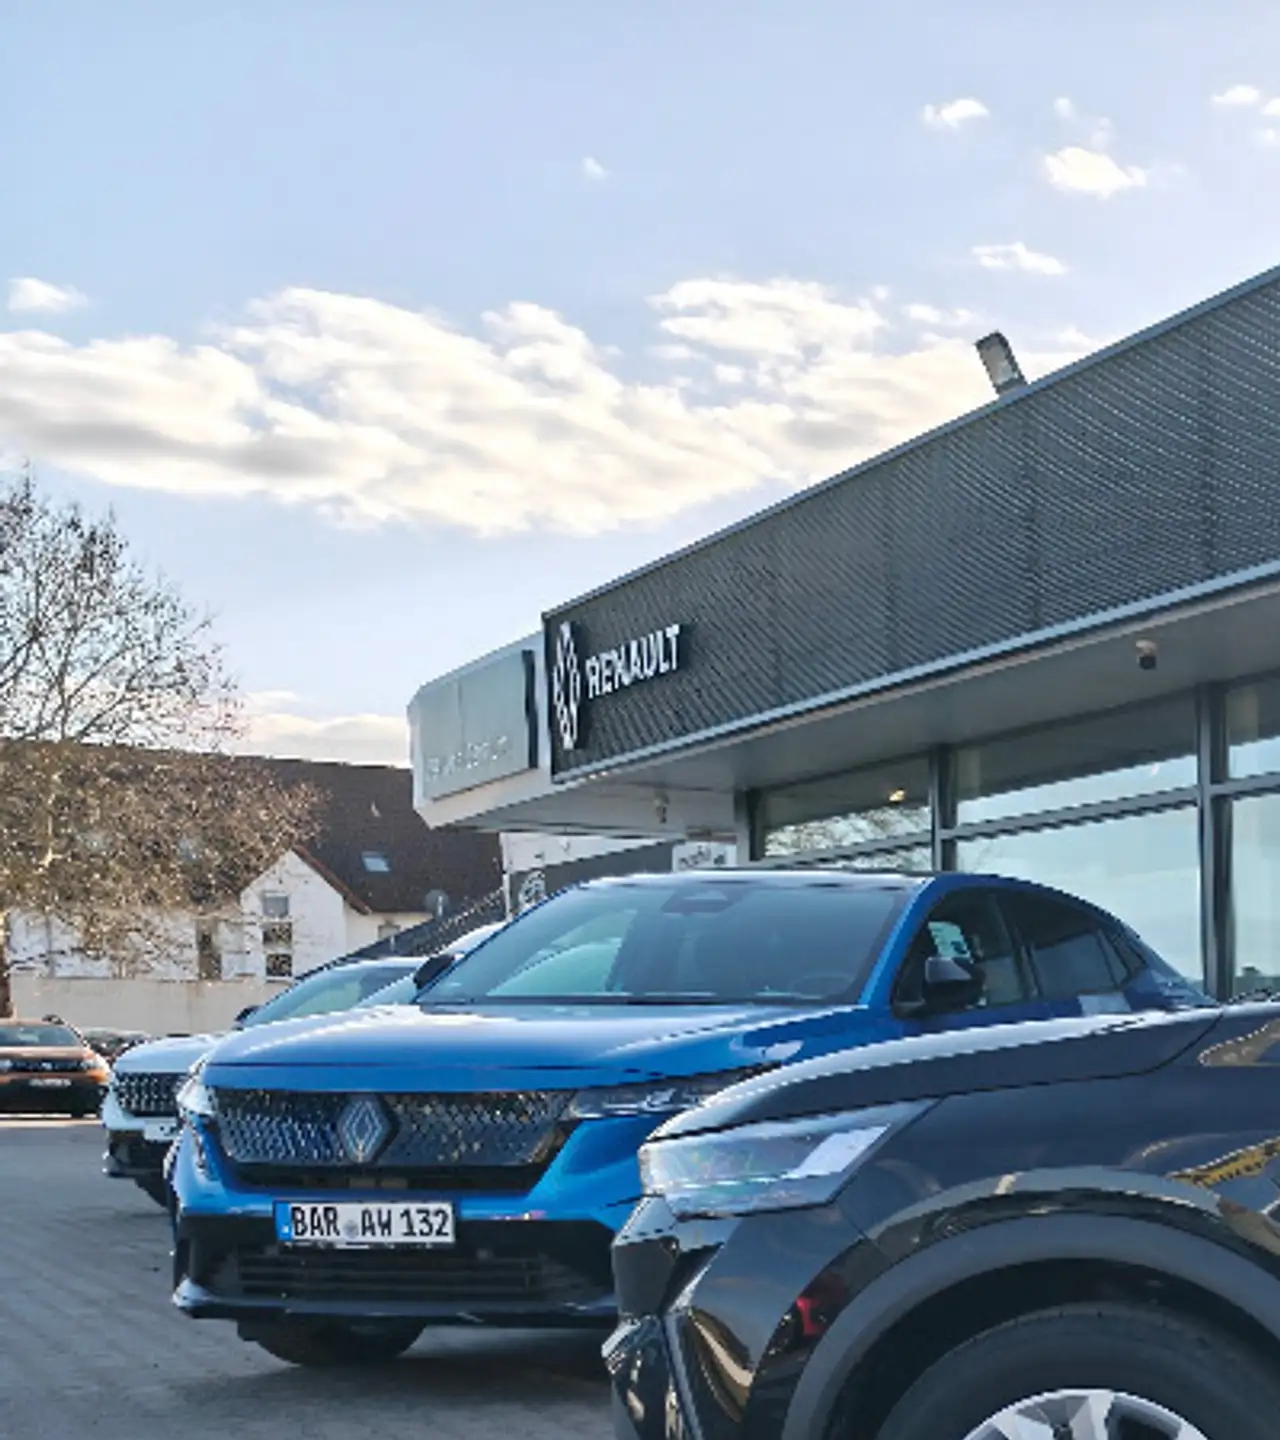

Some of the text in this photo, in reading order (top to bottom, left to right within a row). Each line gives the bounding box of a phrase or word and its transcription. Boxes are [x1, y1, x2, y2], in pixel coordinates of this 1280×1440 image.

[585, 623, 679, 699] RENAULT
[291, 1206, 341, 1237] BAR
[400, 1208, 450, 1237] 132
